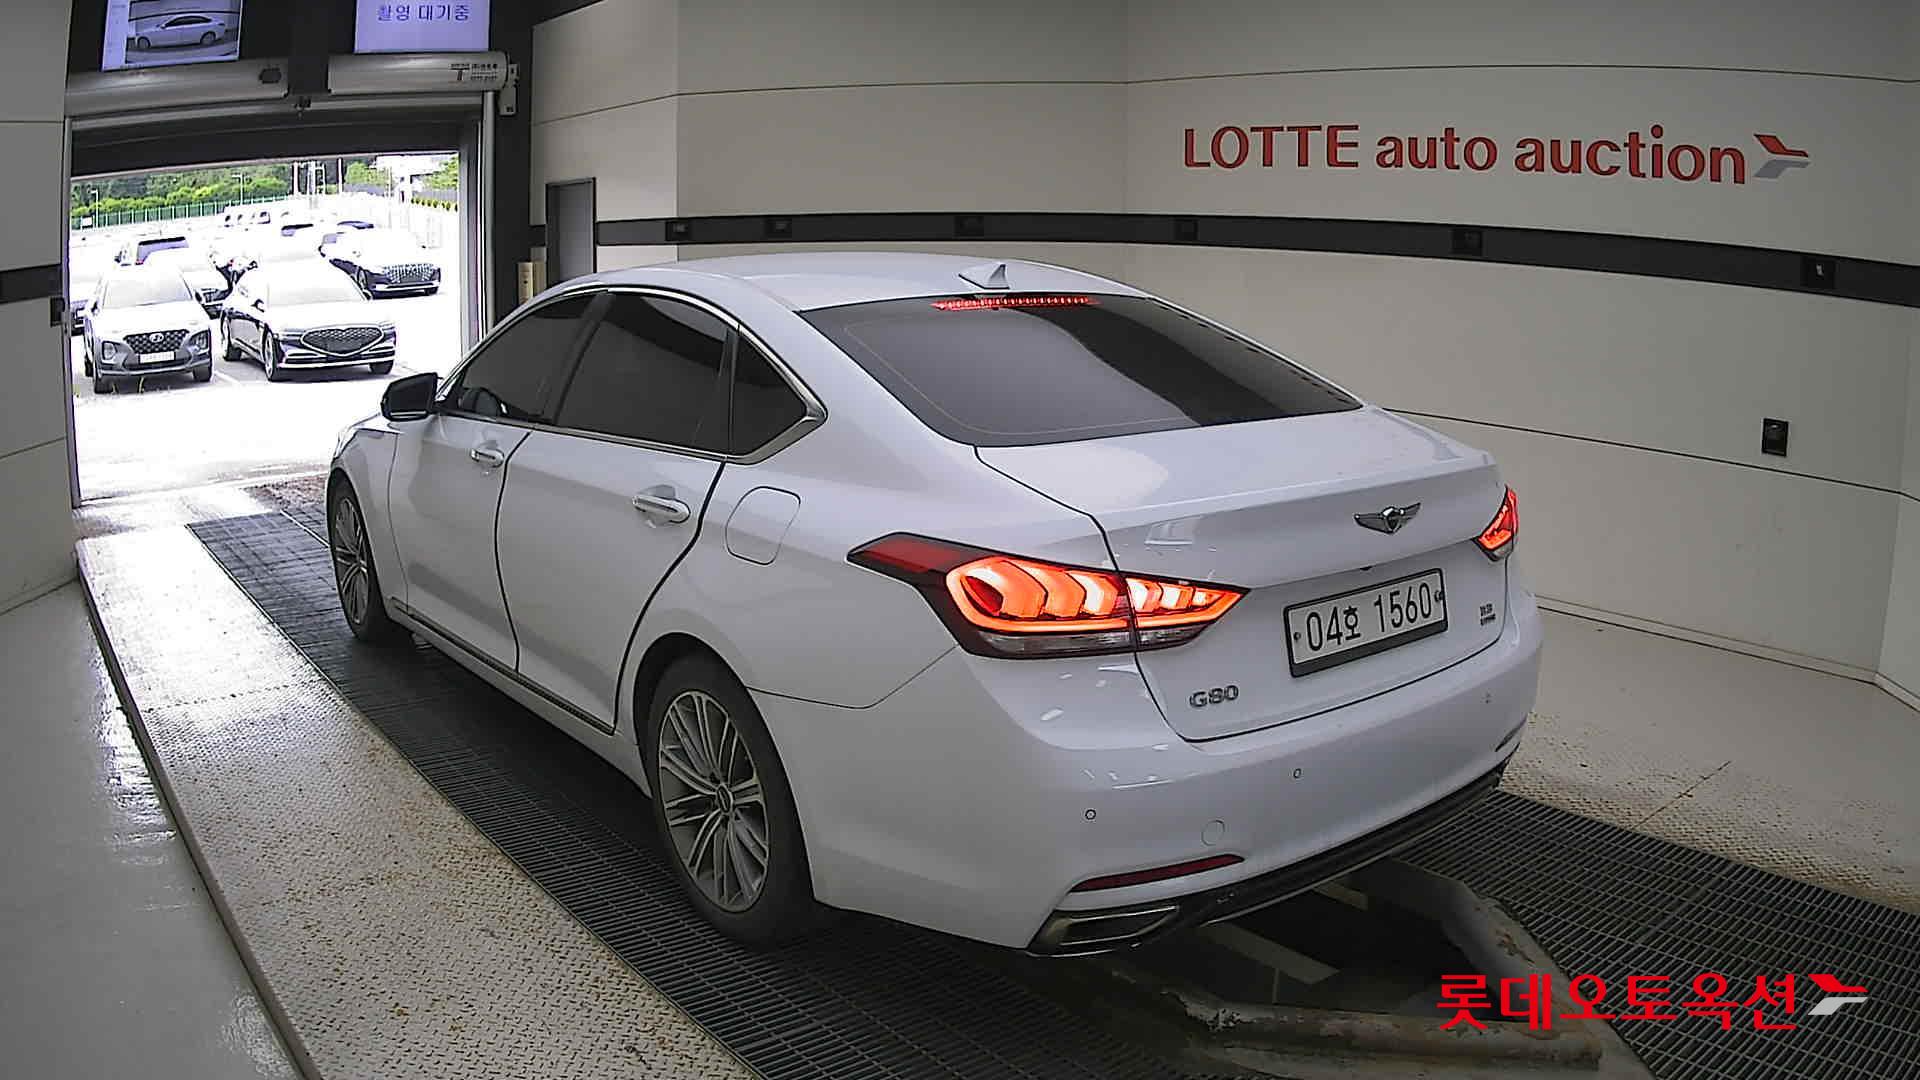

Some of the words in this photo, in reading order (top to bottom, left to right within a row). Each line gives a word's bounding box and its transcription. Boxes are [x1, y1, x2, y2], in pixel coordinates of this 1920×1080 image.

[418, 4, 470, 21] 대기중
[1184, 124, 1360, 169] LOTTE
[1376, 126, 1498, 171] auto
[1515, 124, 1746, 184] auction
[1305, 605, 1361, 651] 04호
[1374, 581, 1433, 633] 1560
[1189, 684, 1240, 708] G80
